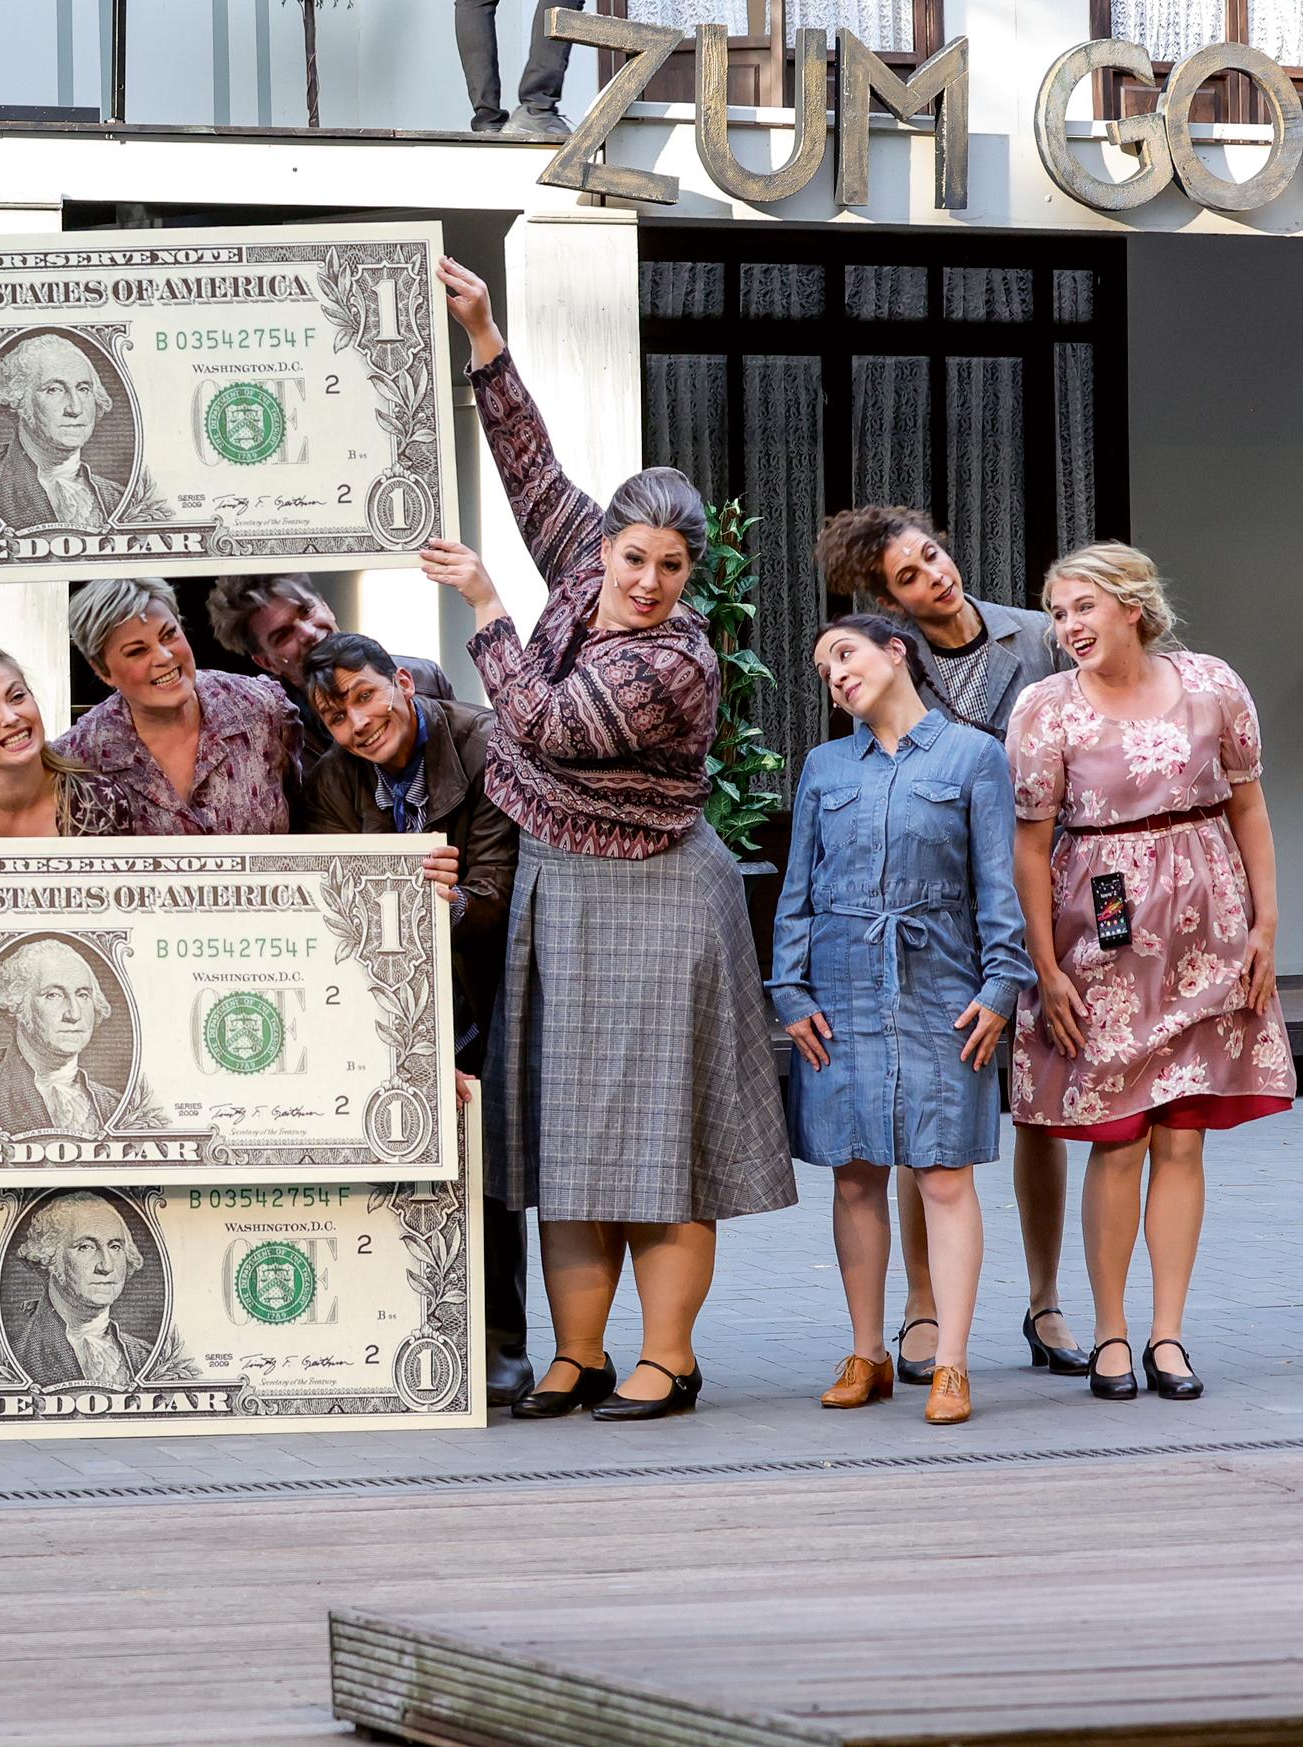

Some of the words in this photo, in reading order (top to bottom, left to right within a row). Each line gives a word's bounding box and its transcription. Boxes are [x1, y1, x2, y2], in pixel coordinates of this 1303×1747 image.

[537, 8, 969, 209] ZUM
[1034, 38, 1303, 212] GO
[2, 249, 151, 270] RESERVE
[153, 247, 239, 265] NOTE
[111, 276, 157, 307] OF
[155, 271, 320, 307] AMERICA
[370, 277, 405, 345] 1
[324, 374, 341, 394] 2
[177, 493, 206, 502] SERIES
[336, 483, 352, 504] 2
[181, 500, 203, 509] 2009
[386, 487, 411, 530] 1
[26, 521, 89, 533] WASHINGTON
[12, 530, 206, 560] DOLLAR
[5, 856, 153, 874] RESERVE
[156, 856, 242, 872] NOTE
[113, 883, 158, 914] OF
[158, 881, 322, 914] AMERICA
[373, 889, 407, 956] 1
[324, 985, 341, 1005] 2
[174, 1101, 203, 1110] SERIES
[334, 1095, 350, 1115] 2
[384, 1100, 408, 1143] 1
[21, 1127, 85, 1137] WASHINGTON
[8, 1138, 202, 1164] DOLLAR
[357, 1234, 373, 1254] 2
[204, 1352, 233, 1361] SERIES
[208, 1359, 230, 1367] 2009
[364, 1344, 380, 1364] 2
[415, 1349, 438, 1391] 1
[52, 1378, 115, 1389] WASHINGTON
[38, 1389, 232, 1416] DOLLAR
